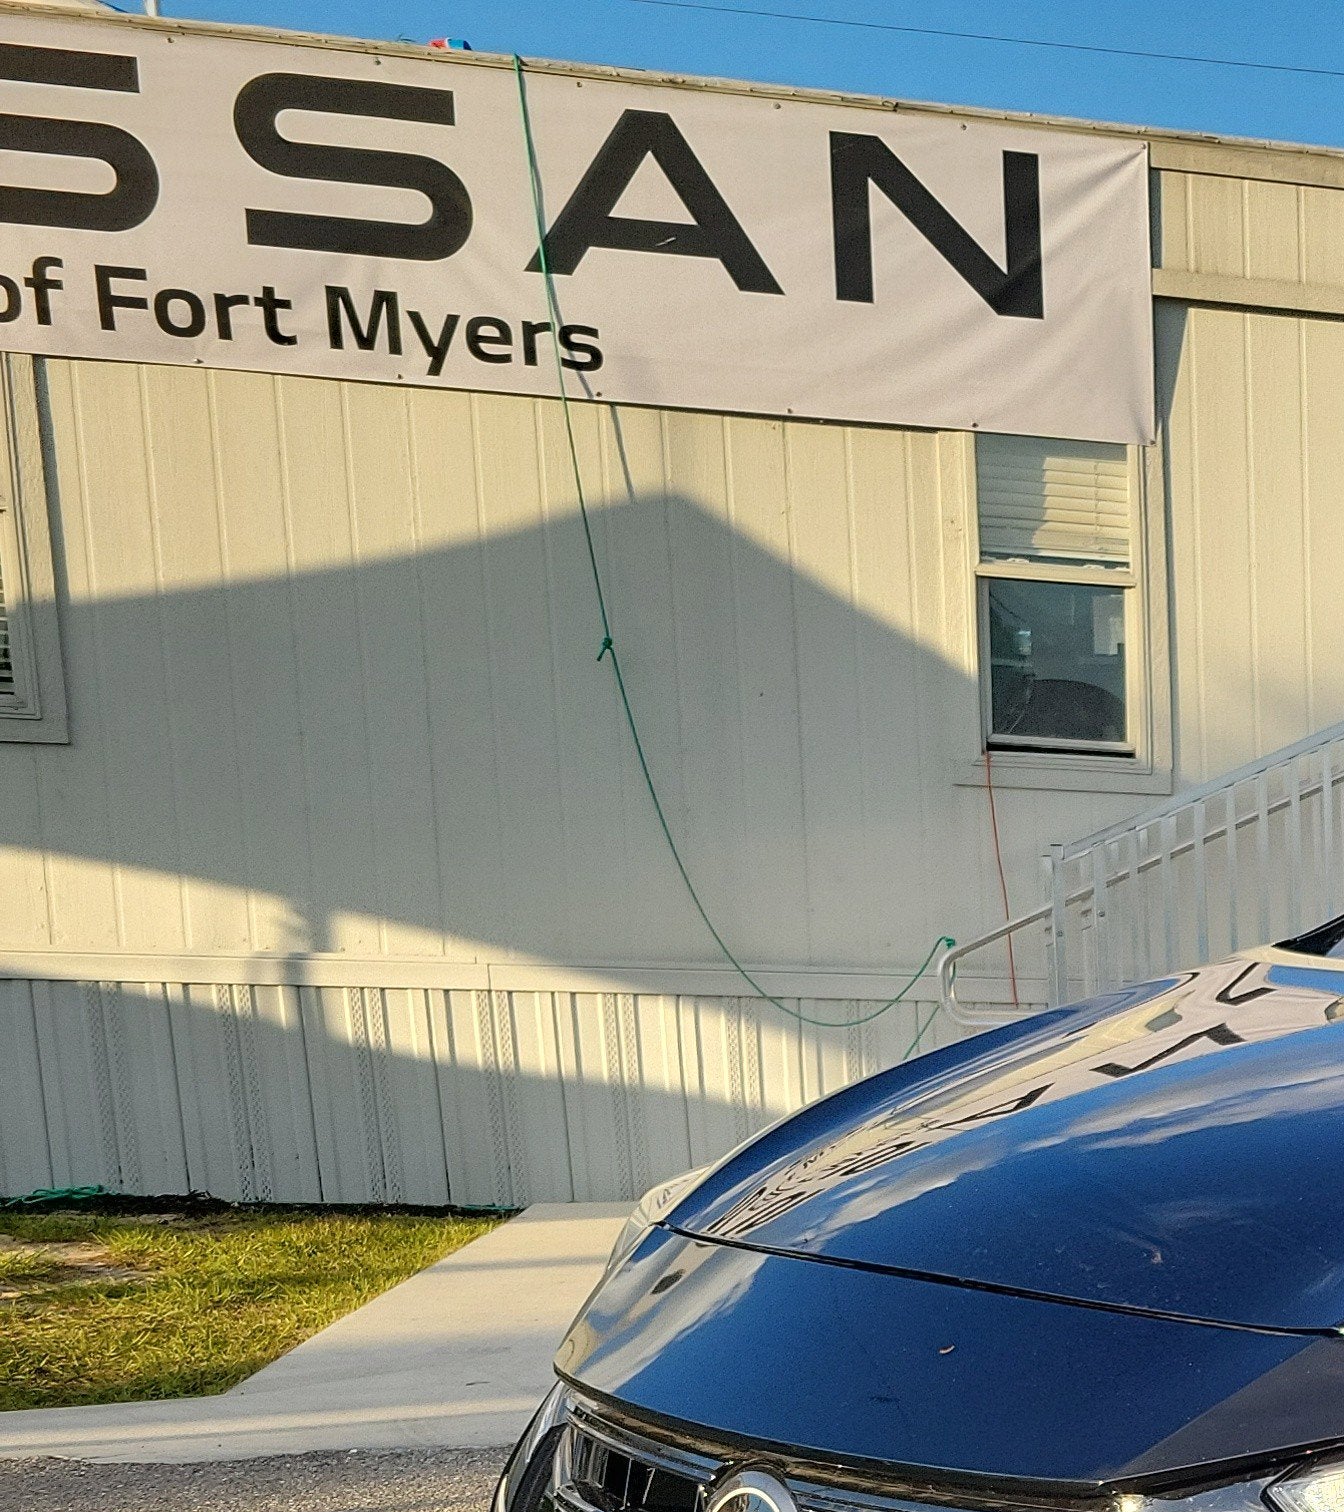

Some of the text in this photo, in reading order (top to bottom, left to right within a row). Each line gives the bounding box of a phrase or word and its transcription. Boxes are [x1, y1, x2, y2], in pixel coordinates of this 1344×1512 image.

[0, 43, 1044, 319] SSAN
[94, 264, 298, 346] Fort
[325, 285, 604, 376] Myers
